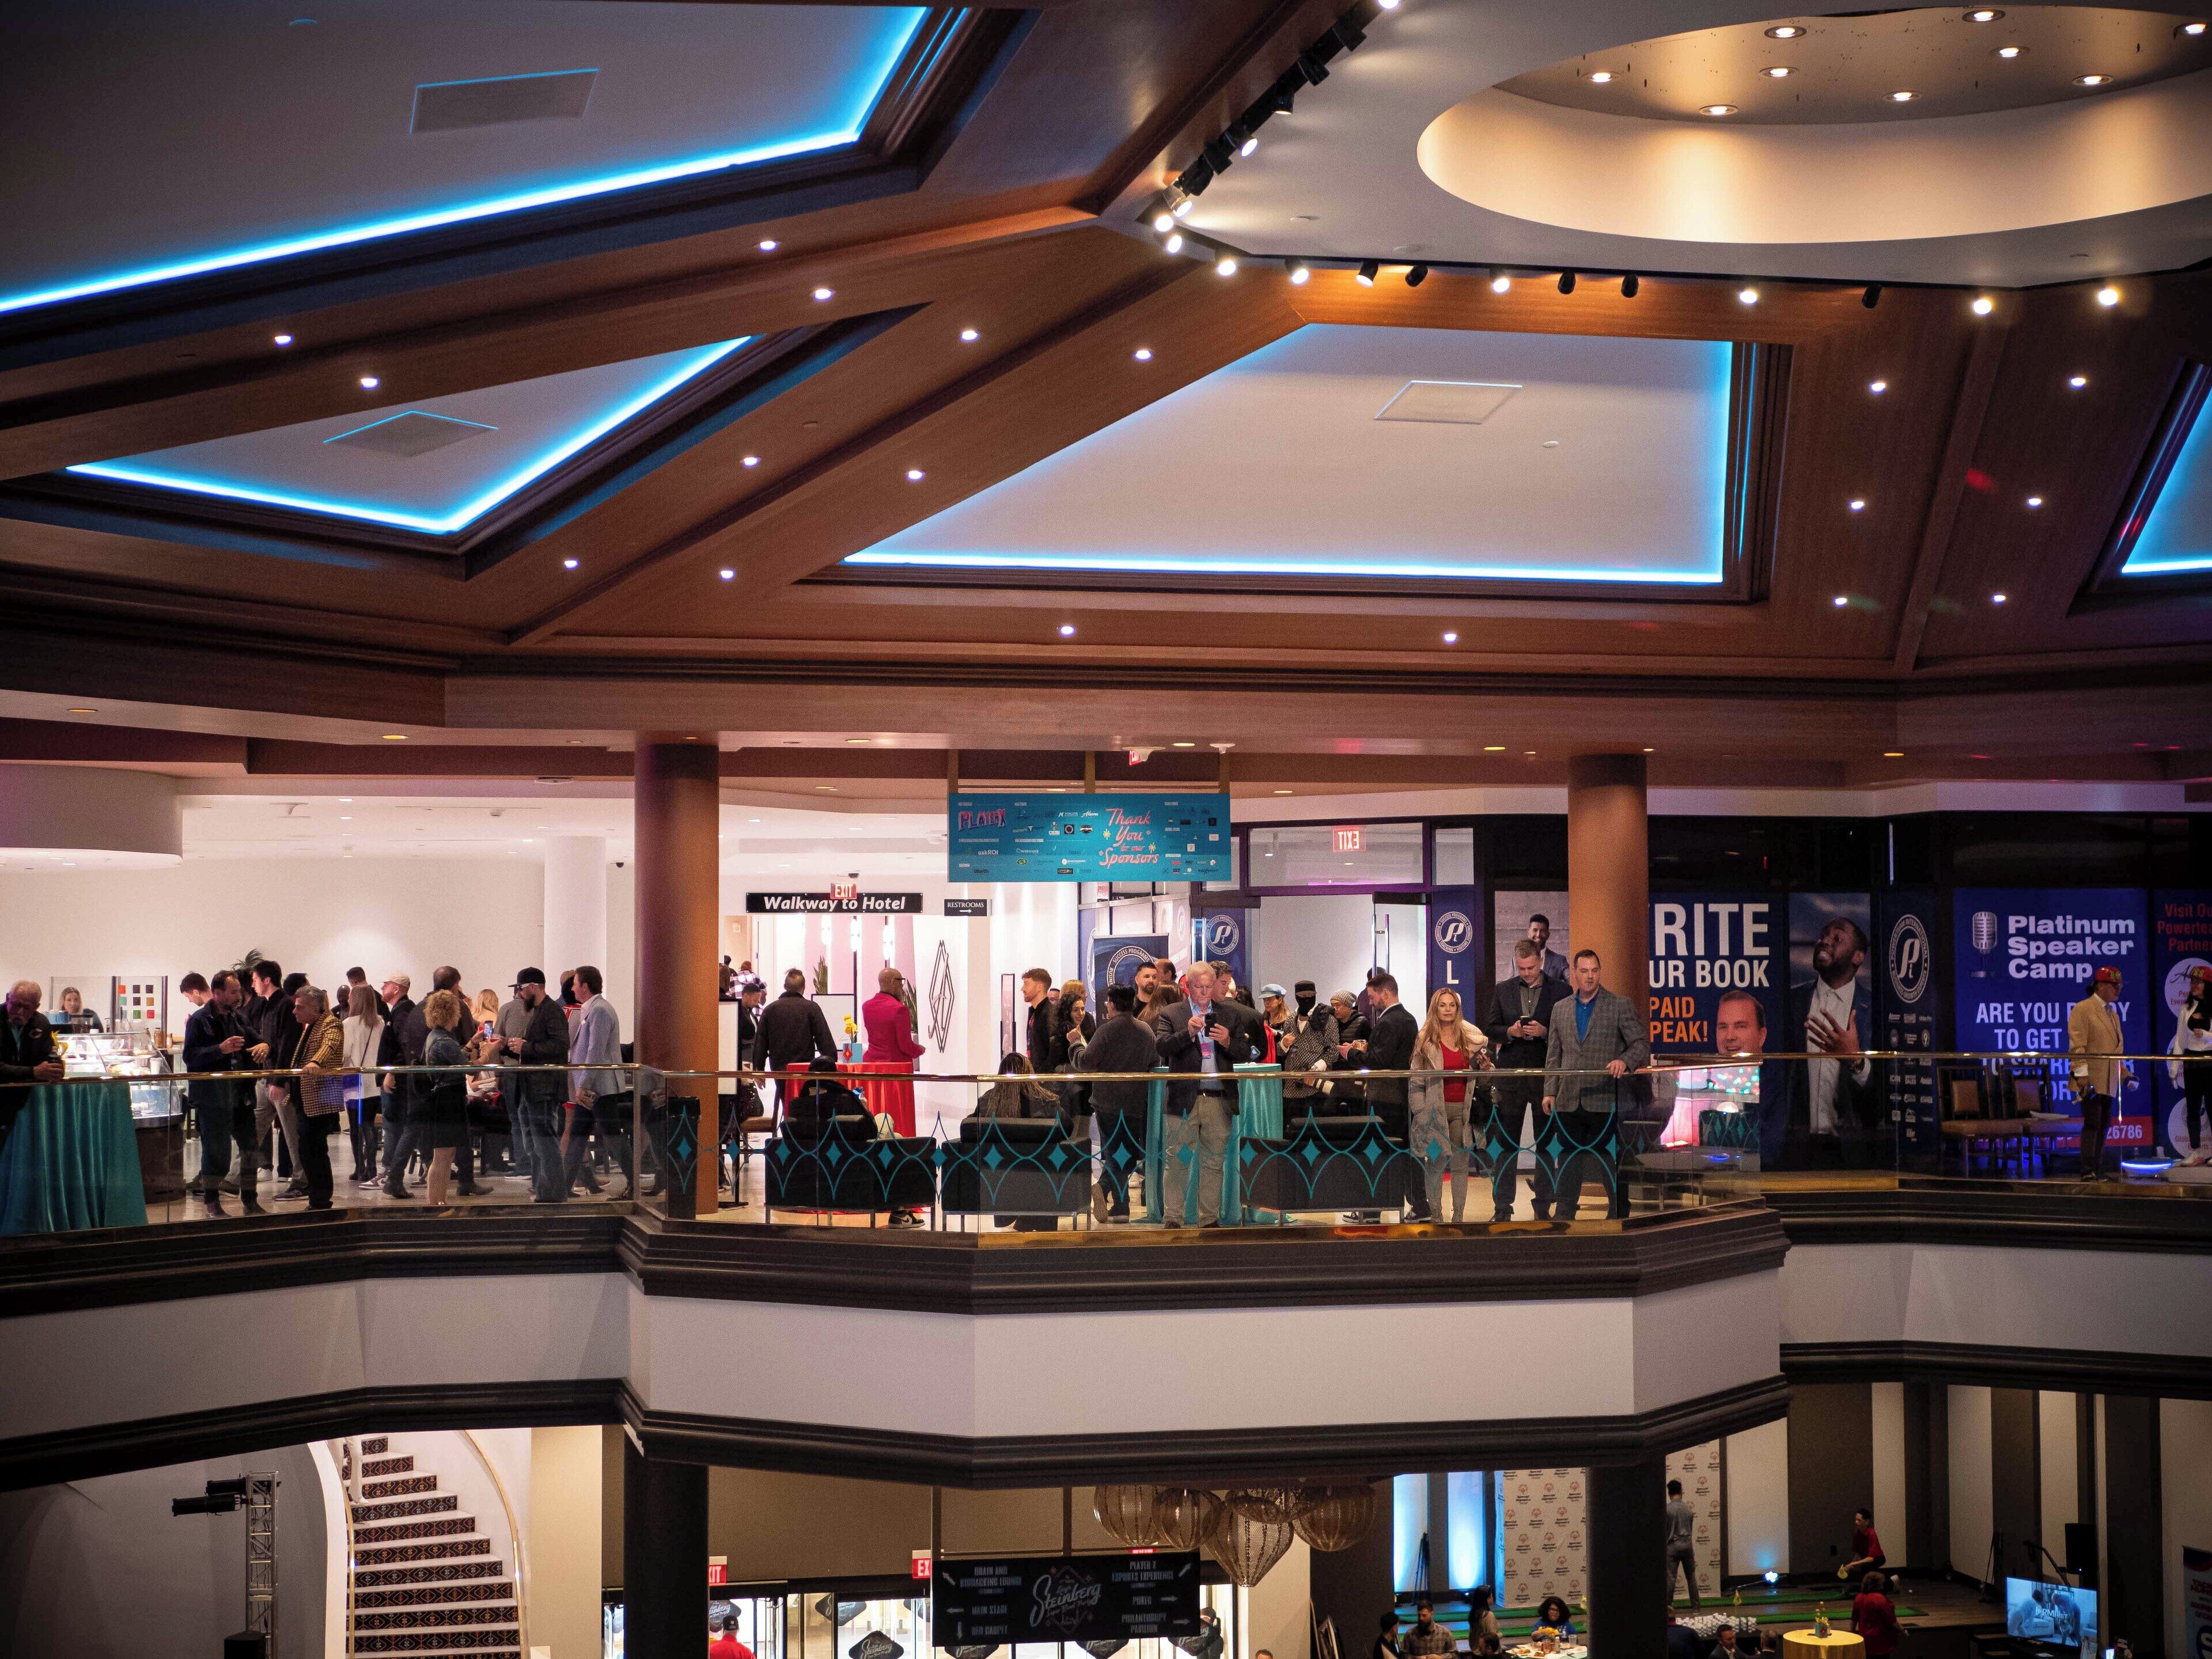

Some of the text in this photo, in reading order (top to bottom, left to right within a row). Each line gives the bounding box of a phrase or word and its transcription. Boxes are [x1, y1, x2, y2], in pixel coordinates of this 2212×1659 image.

[1106, 808, 1150, 826] Thank
[1113, 825, 1143, 847] You
[1099, 847, 1160, 869] Sponsors
[834, 884, 853, 898] EXIT
[764, 896, 905, 911] Walkway to Hotel
[2165, 903, 2193, 918] Visit
[1649, 903, 1770, 956] RITE
[2008, 915, 2135, 934] Platinum
[1112, 948, 1150, 964] SUCCESS PROGRAMS
[2008, 935, 2134, 959] Speaker
[1696, 959, 1770, 988] BOOK
[2008, 957, 2093, 983] Camp
[1649, 997, 1695, 1018] PAID
[1976, 1002, 2014, 1023] ARE
[2020, 1002, 2059, 1023] YOU
[1994, 1028, 2062, 1050] TO GET
[1130, 1561, 1151, 1570] PLAYER
[1140, 1571, 1173, 1581] EXPERIENCE
[972, 1605, 1007, 1615] MAIN STAGE
[1030, 1574, 1101, 1627] Steinberg
[985, 1625, 1007, 1635] CARPET
